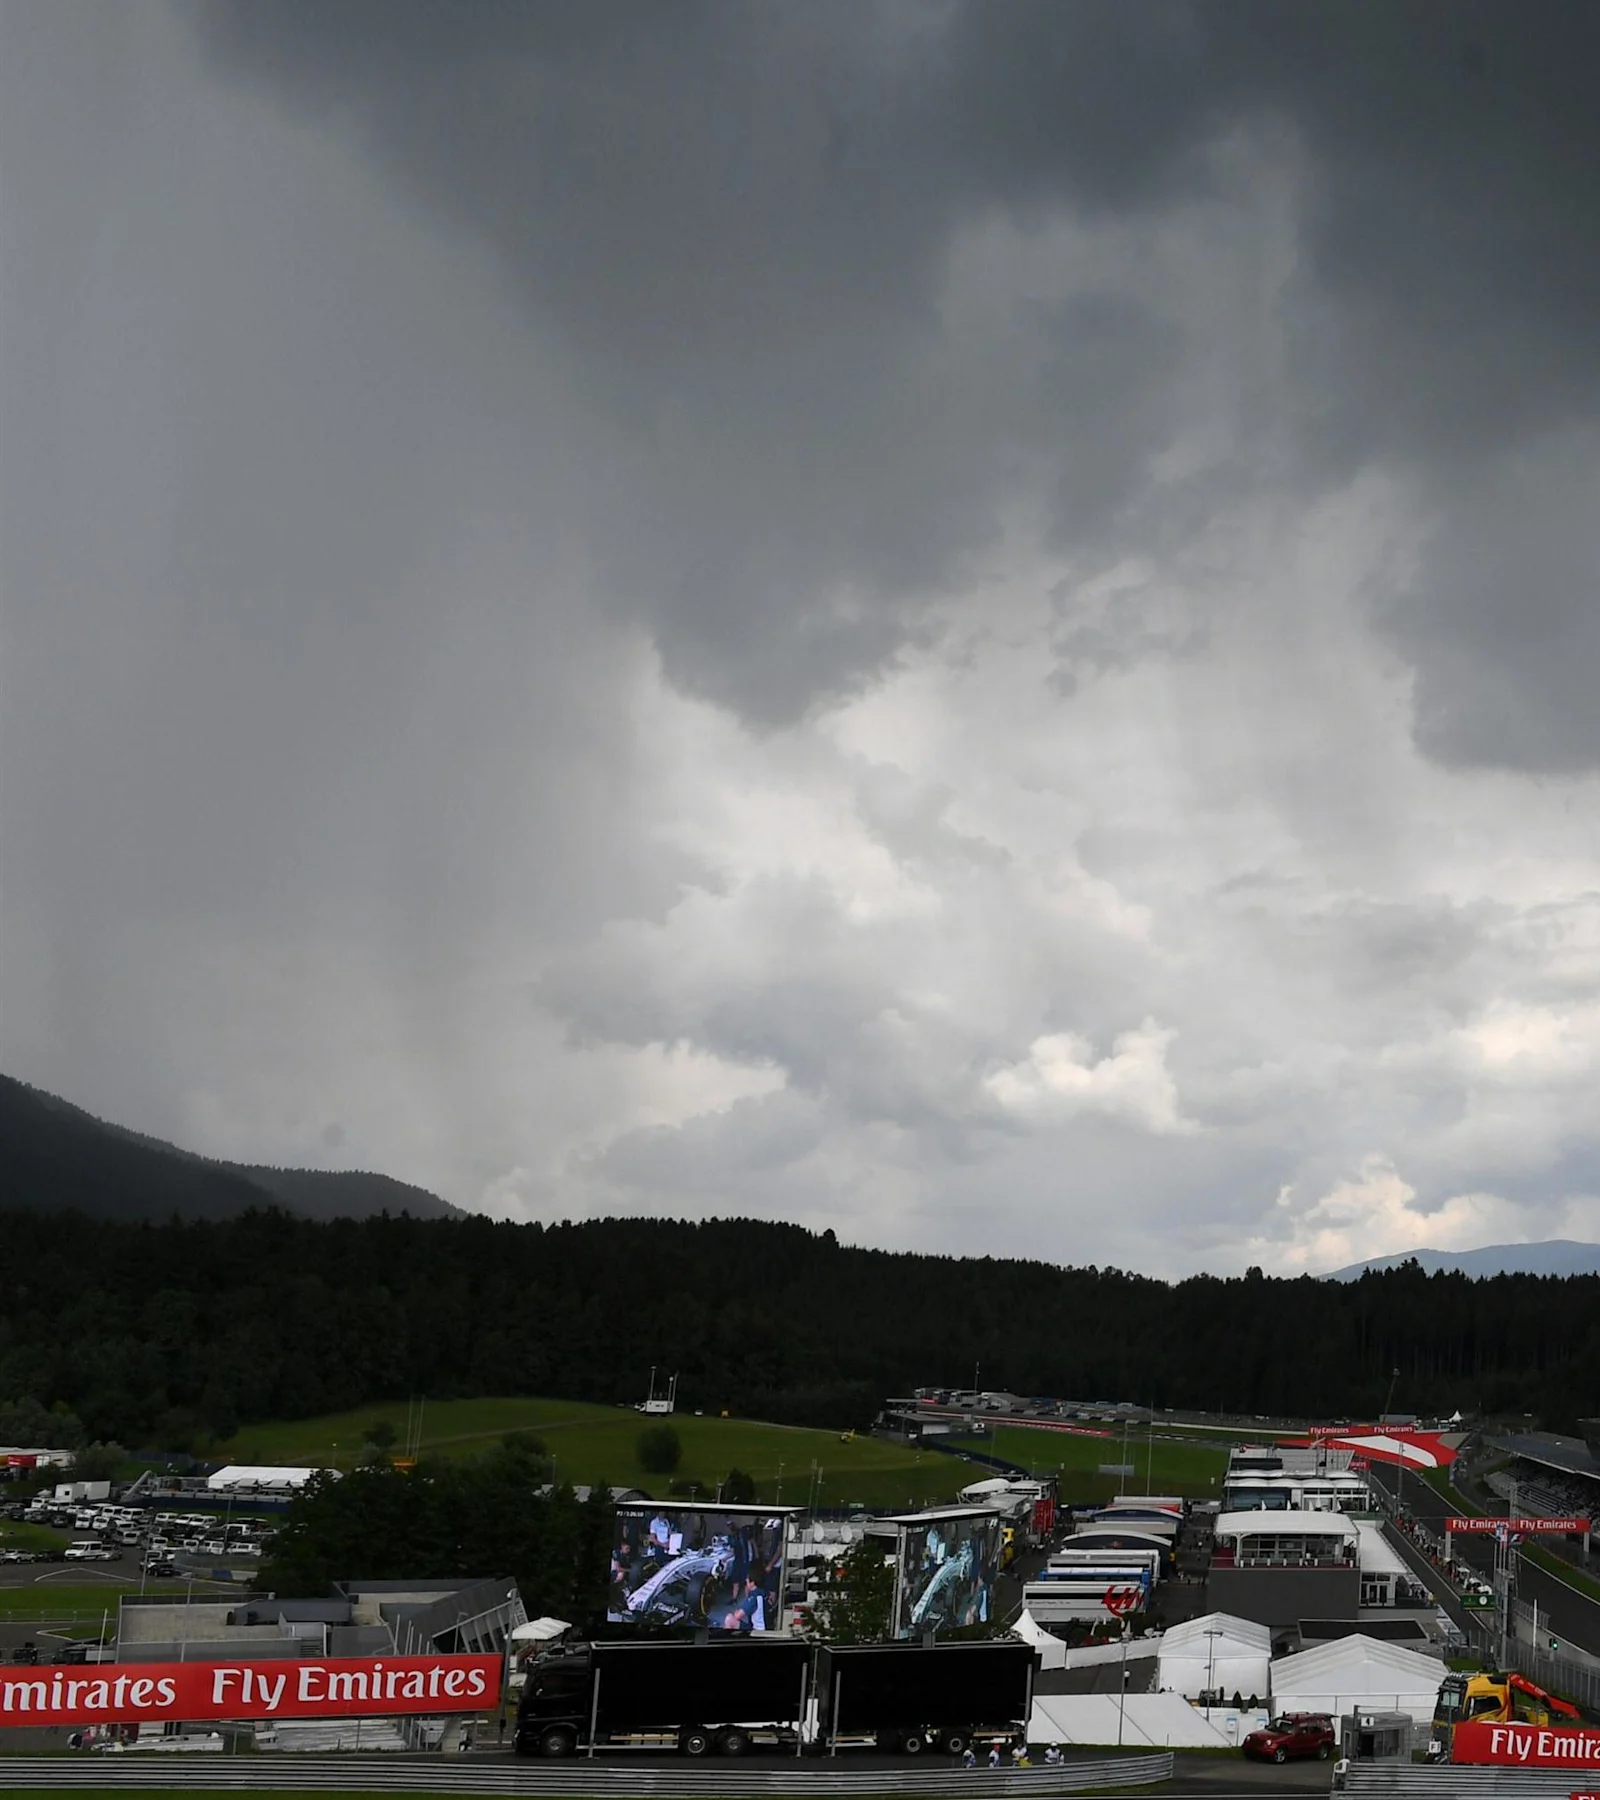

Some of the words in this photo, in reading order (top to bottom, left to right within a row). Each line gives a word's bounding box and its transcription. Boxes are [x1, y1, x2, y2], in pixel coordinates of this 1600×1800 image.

[1310, 1427, 1322, 1435] Fly
[1322, 1426, 1350, 1434] Emirates
[1374, 1425, 1386, 1434] Fly
[1386, 1424, 1413, 1433] Emirates
[1452, 1519, 1468, 1531] Fly
[1469, 1519, 1511, 1530] Emirates
[1519, 1519, 1537, 1531] Fly
[1536, 1519, 1577, 1530] Emirates
[0, 1671, 176, 1711] mirates
[211, 1667, 287, 1711] Fly
[297, 1662, 486, 1702] Emirates
[1490, 1728, 1532, 1761] Fly
